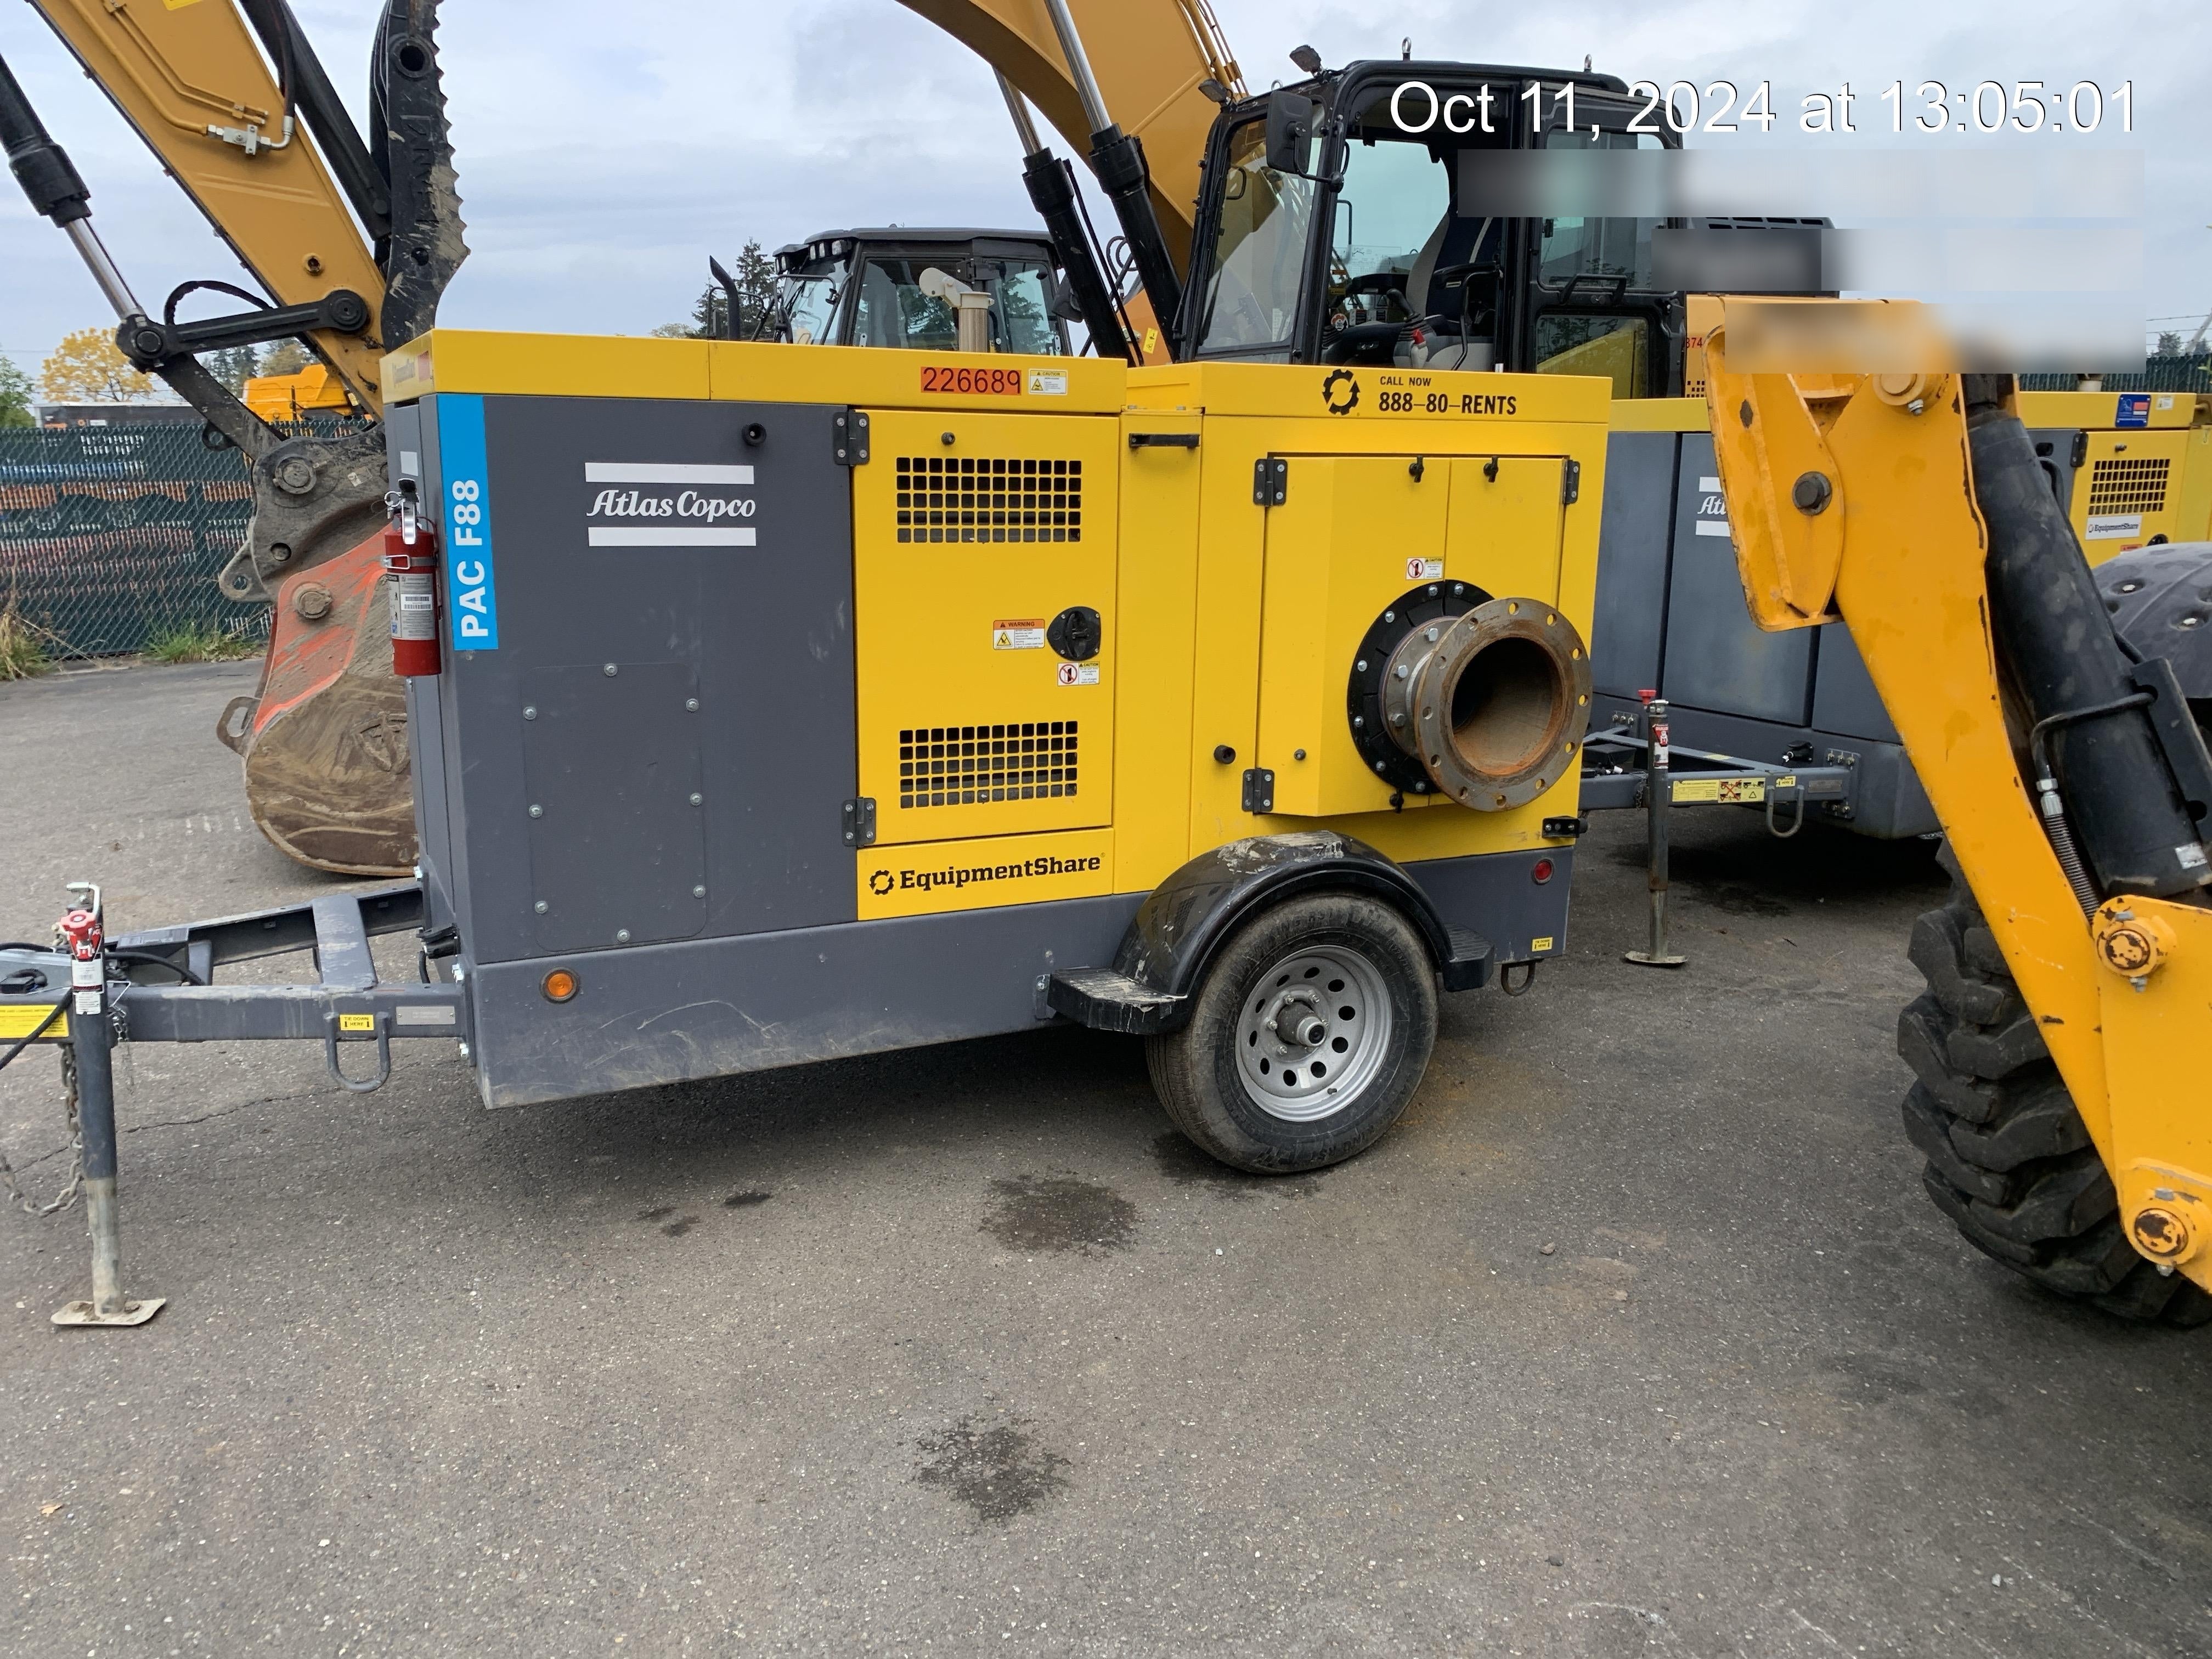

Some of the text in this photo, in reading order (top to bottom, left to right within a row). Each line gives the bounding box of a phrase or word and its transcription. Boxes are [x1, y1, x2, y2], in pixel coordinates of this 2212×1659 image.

[923, 367, 1021, 394] 226689
[1379, 376, 1431, 387] CALL NOW
[1379, 392, 1517, 415] 888-80-RENTS
[586, 489, 756, 523] Atlas Copco
[452, 479, 488, 637] PAC F88
[900, 856, 1101, 892] EquipmentShare
